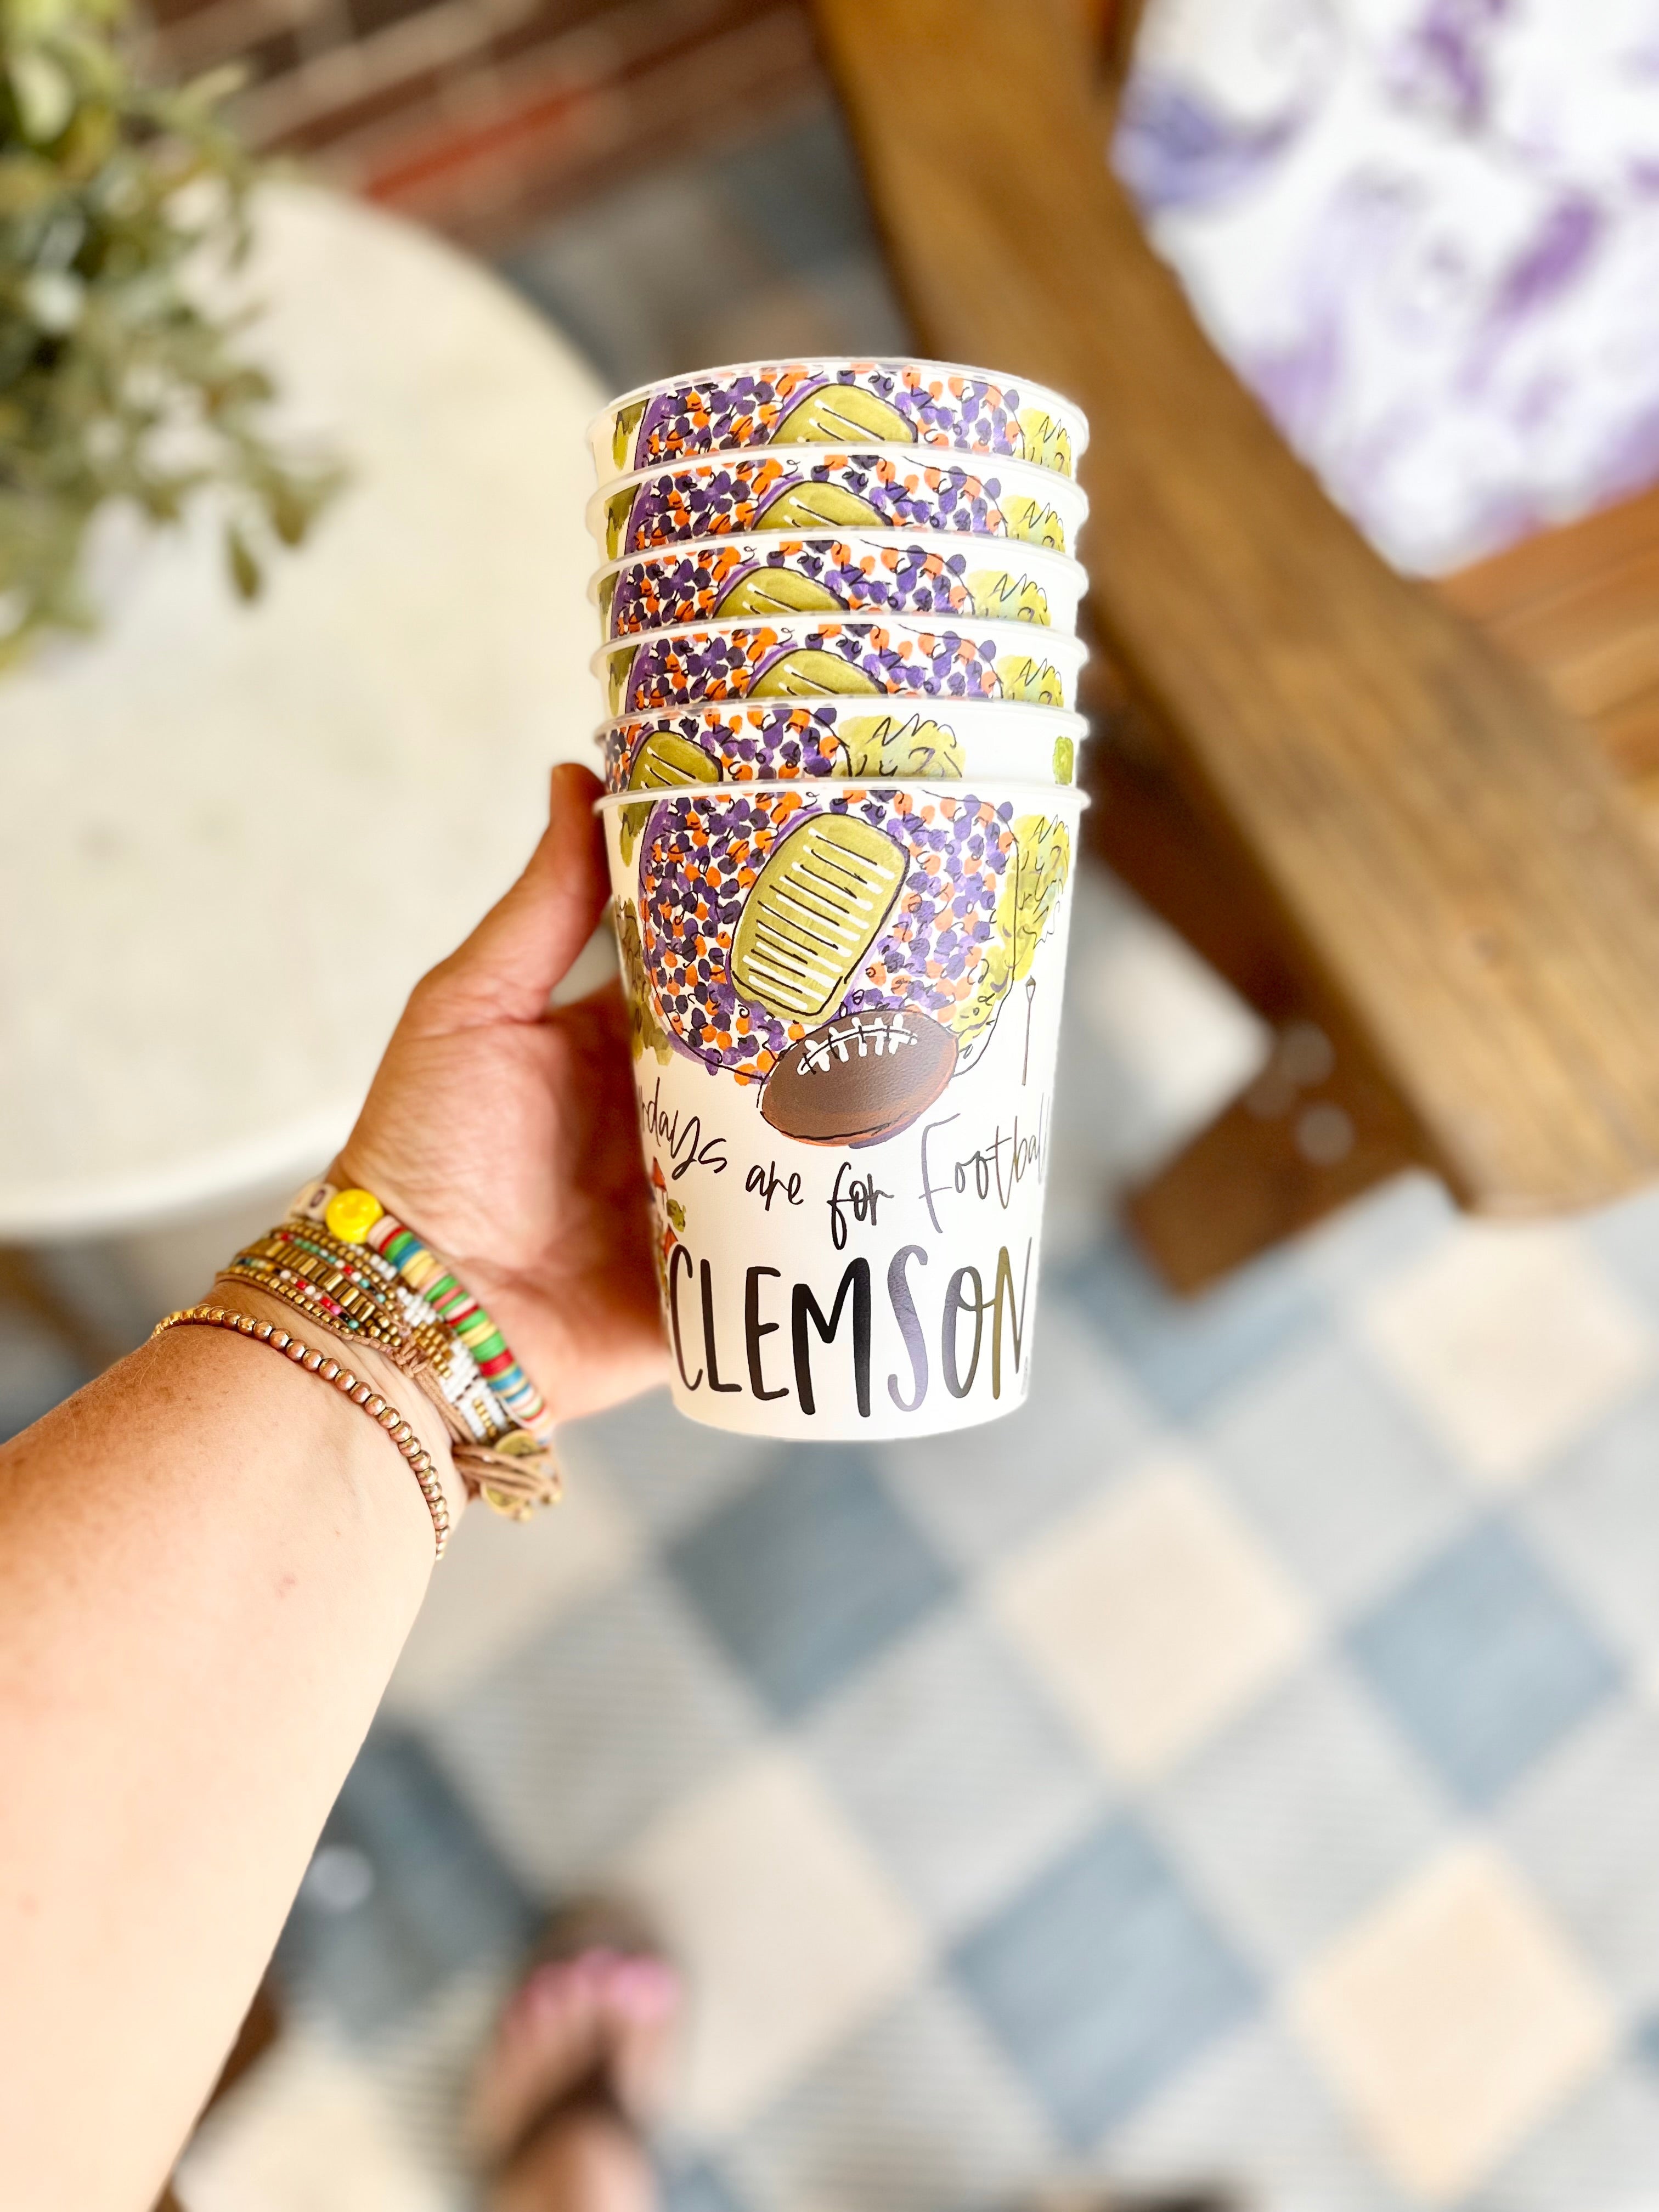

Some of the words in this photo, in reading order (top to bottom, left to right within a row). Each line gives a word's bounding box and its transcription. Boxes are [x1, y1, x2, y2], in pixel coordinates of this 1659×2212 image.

[745, 1160, 804, 1211] are
[826, 1161, 895, 1250] for
[669, 1237, 1032, 1418] CLEMSON
